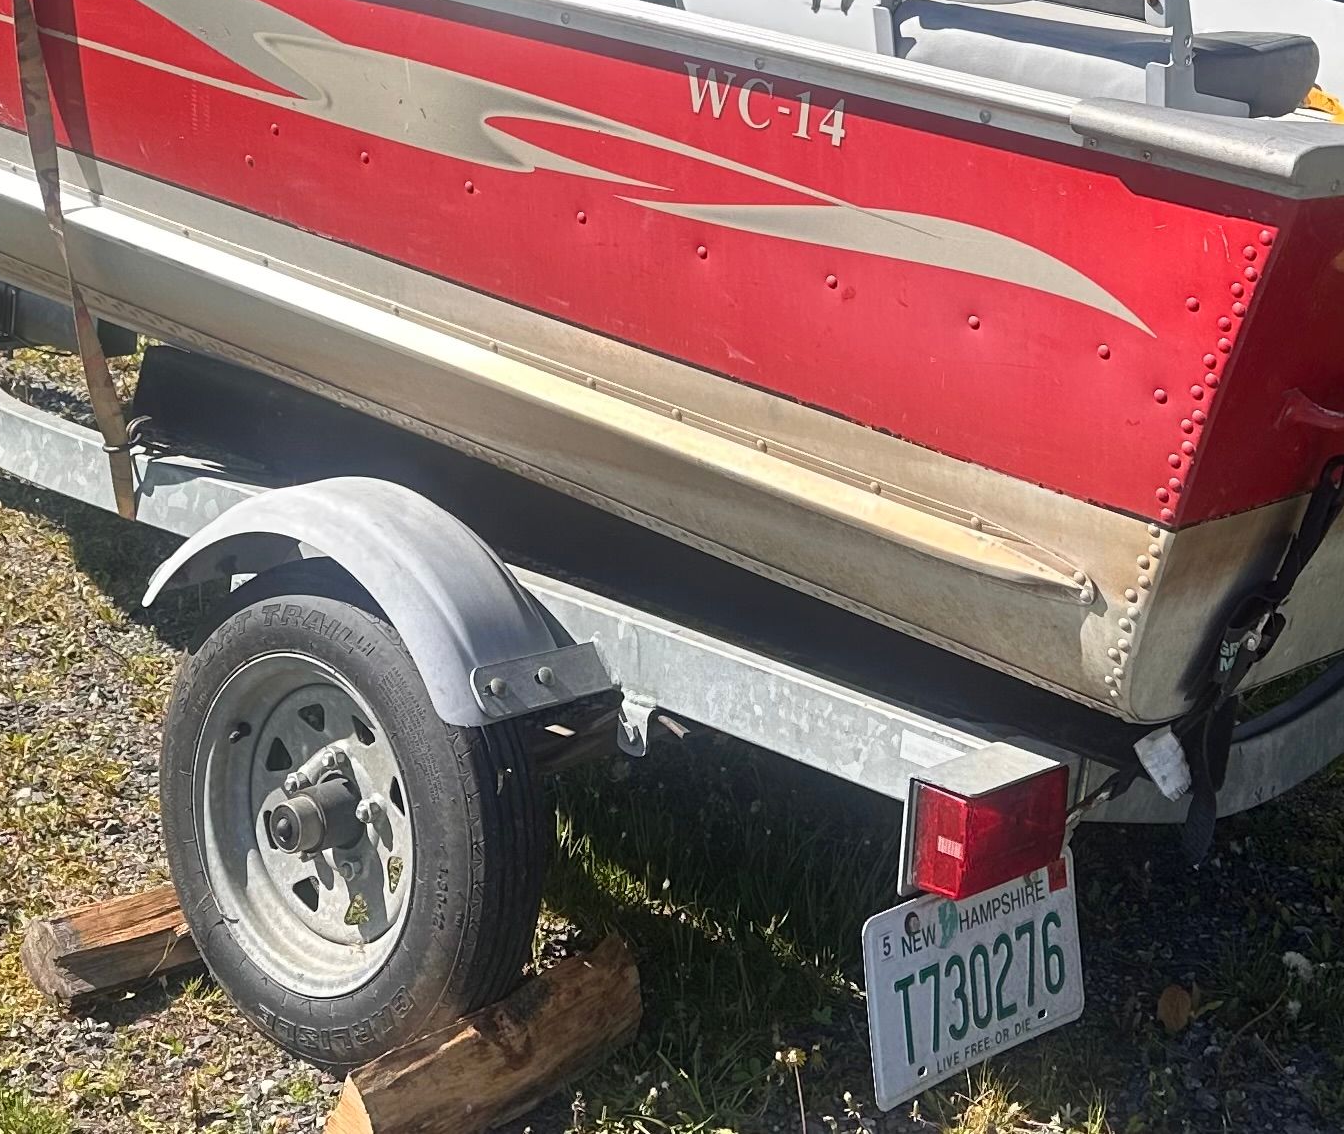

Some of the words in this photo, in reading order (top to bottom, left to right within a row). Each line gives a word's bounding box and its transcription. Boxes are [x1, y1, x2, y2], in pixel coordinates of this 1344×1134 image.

[684, 61, 846, 147] WC-14
[262, 603, 354, 655] TRAIL
[882, 935, 892, 957] 5
[901, 923, 937, 958] NEW
[958, 879, 1046, 933] HAMPSHIRE
[257, 985, 416, 1050] CARLISLE
[894, 911, 1066, 1065] T730276
[936, 1051, 960, 1074] LIVE
[964, 1036, 991, 1059] FREE
[995, 1028, 1010, 1045] OR
[1014, 1017, 1031, 1036] DIE
